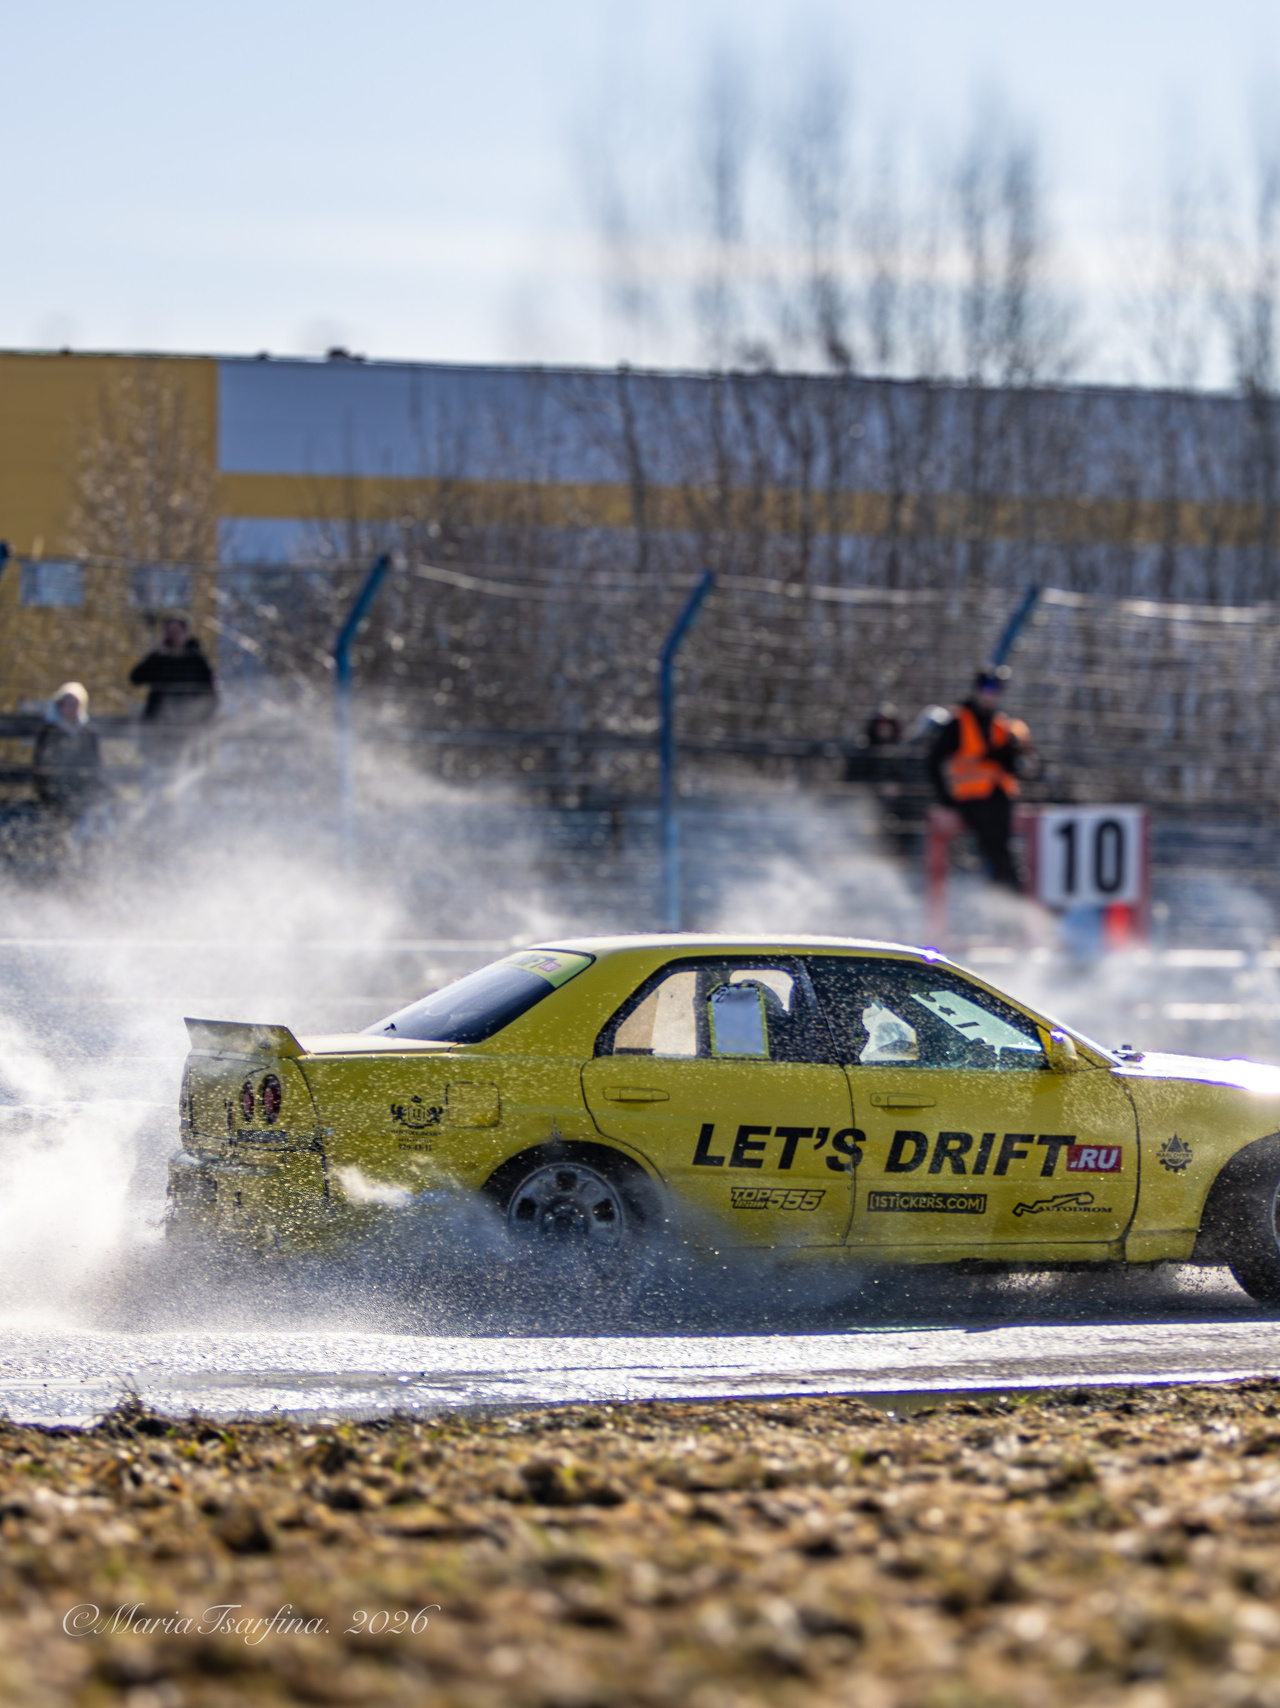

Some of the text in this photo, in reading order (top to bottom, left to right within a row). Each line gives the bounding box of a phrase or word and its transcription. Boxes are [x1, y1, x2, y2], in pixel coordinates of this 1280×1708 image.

[1053, 819, 1126, 895] 10
[692, 1123, 866, 1173] LET'S
[1037, 1205, 1113, 1213] AUTODROM
